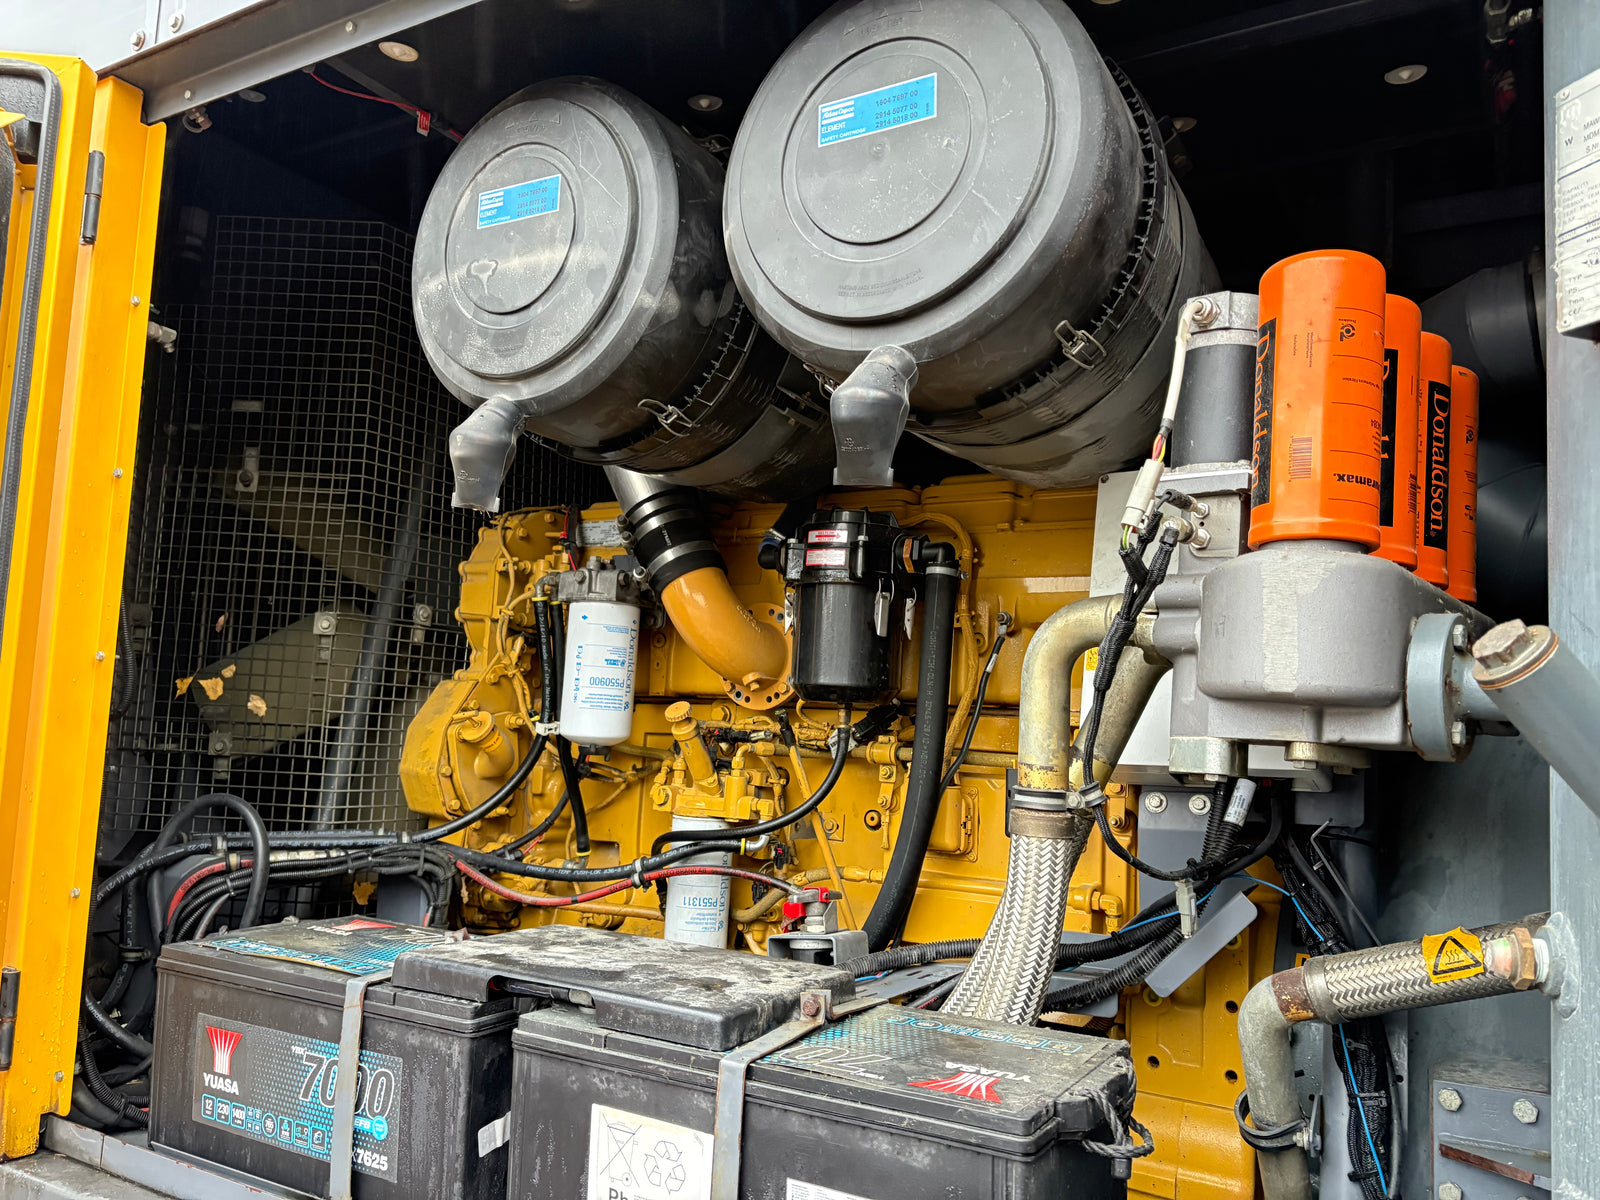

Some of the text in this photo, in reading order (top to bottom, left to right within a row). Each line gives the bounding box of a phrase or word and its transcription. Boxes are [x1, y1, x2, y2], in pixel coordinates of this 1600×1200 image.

[822, 121, 846, 134] ELEMENT
[1252, 330, 1270, 489] Donaldson
[1430, 390, 1450, 531] Donaldson
[1336, 473, 1381, 491] uramax
[625, 628, 637, 696] Donaldson
[590, 676, 625, 688] P550900
[683, 896, 718, 907] P551311
[945, 1061, 1032, 1083] YUASA
[203, 1072, 240, 1096] YUASA
[205, 1099, 212, 1110] 12
[218, 1102, 229, 1115] 230
[233, 1108, 245, 1120] 1400
[355, 1119, 371, 1129] EFB
